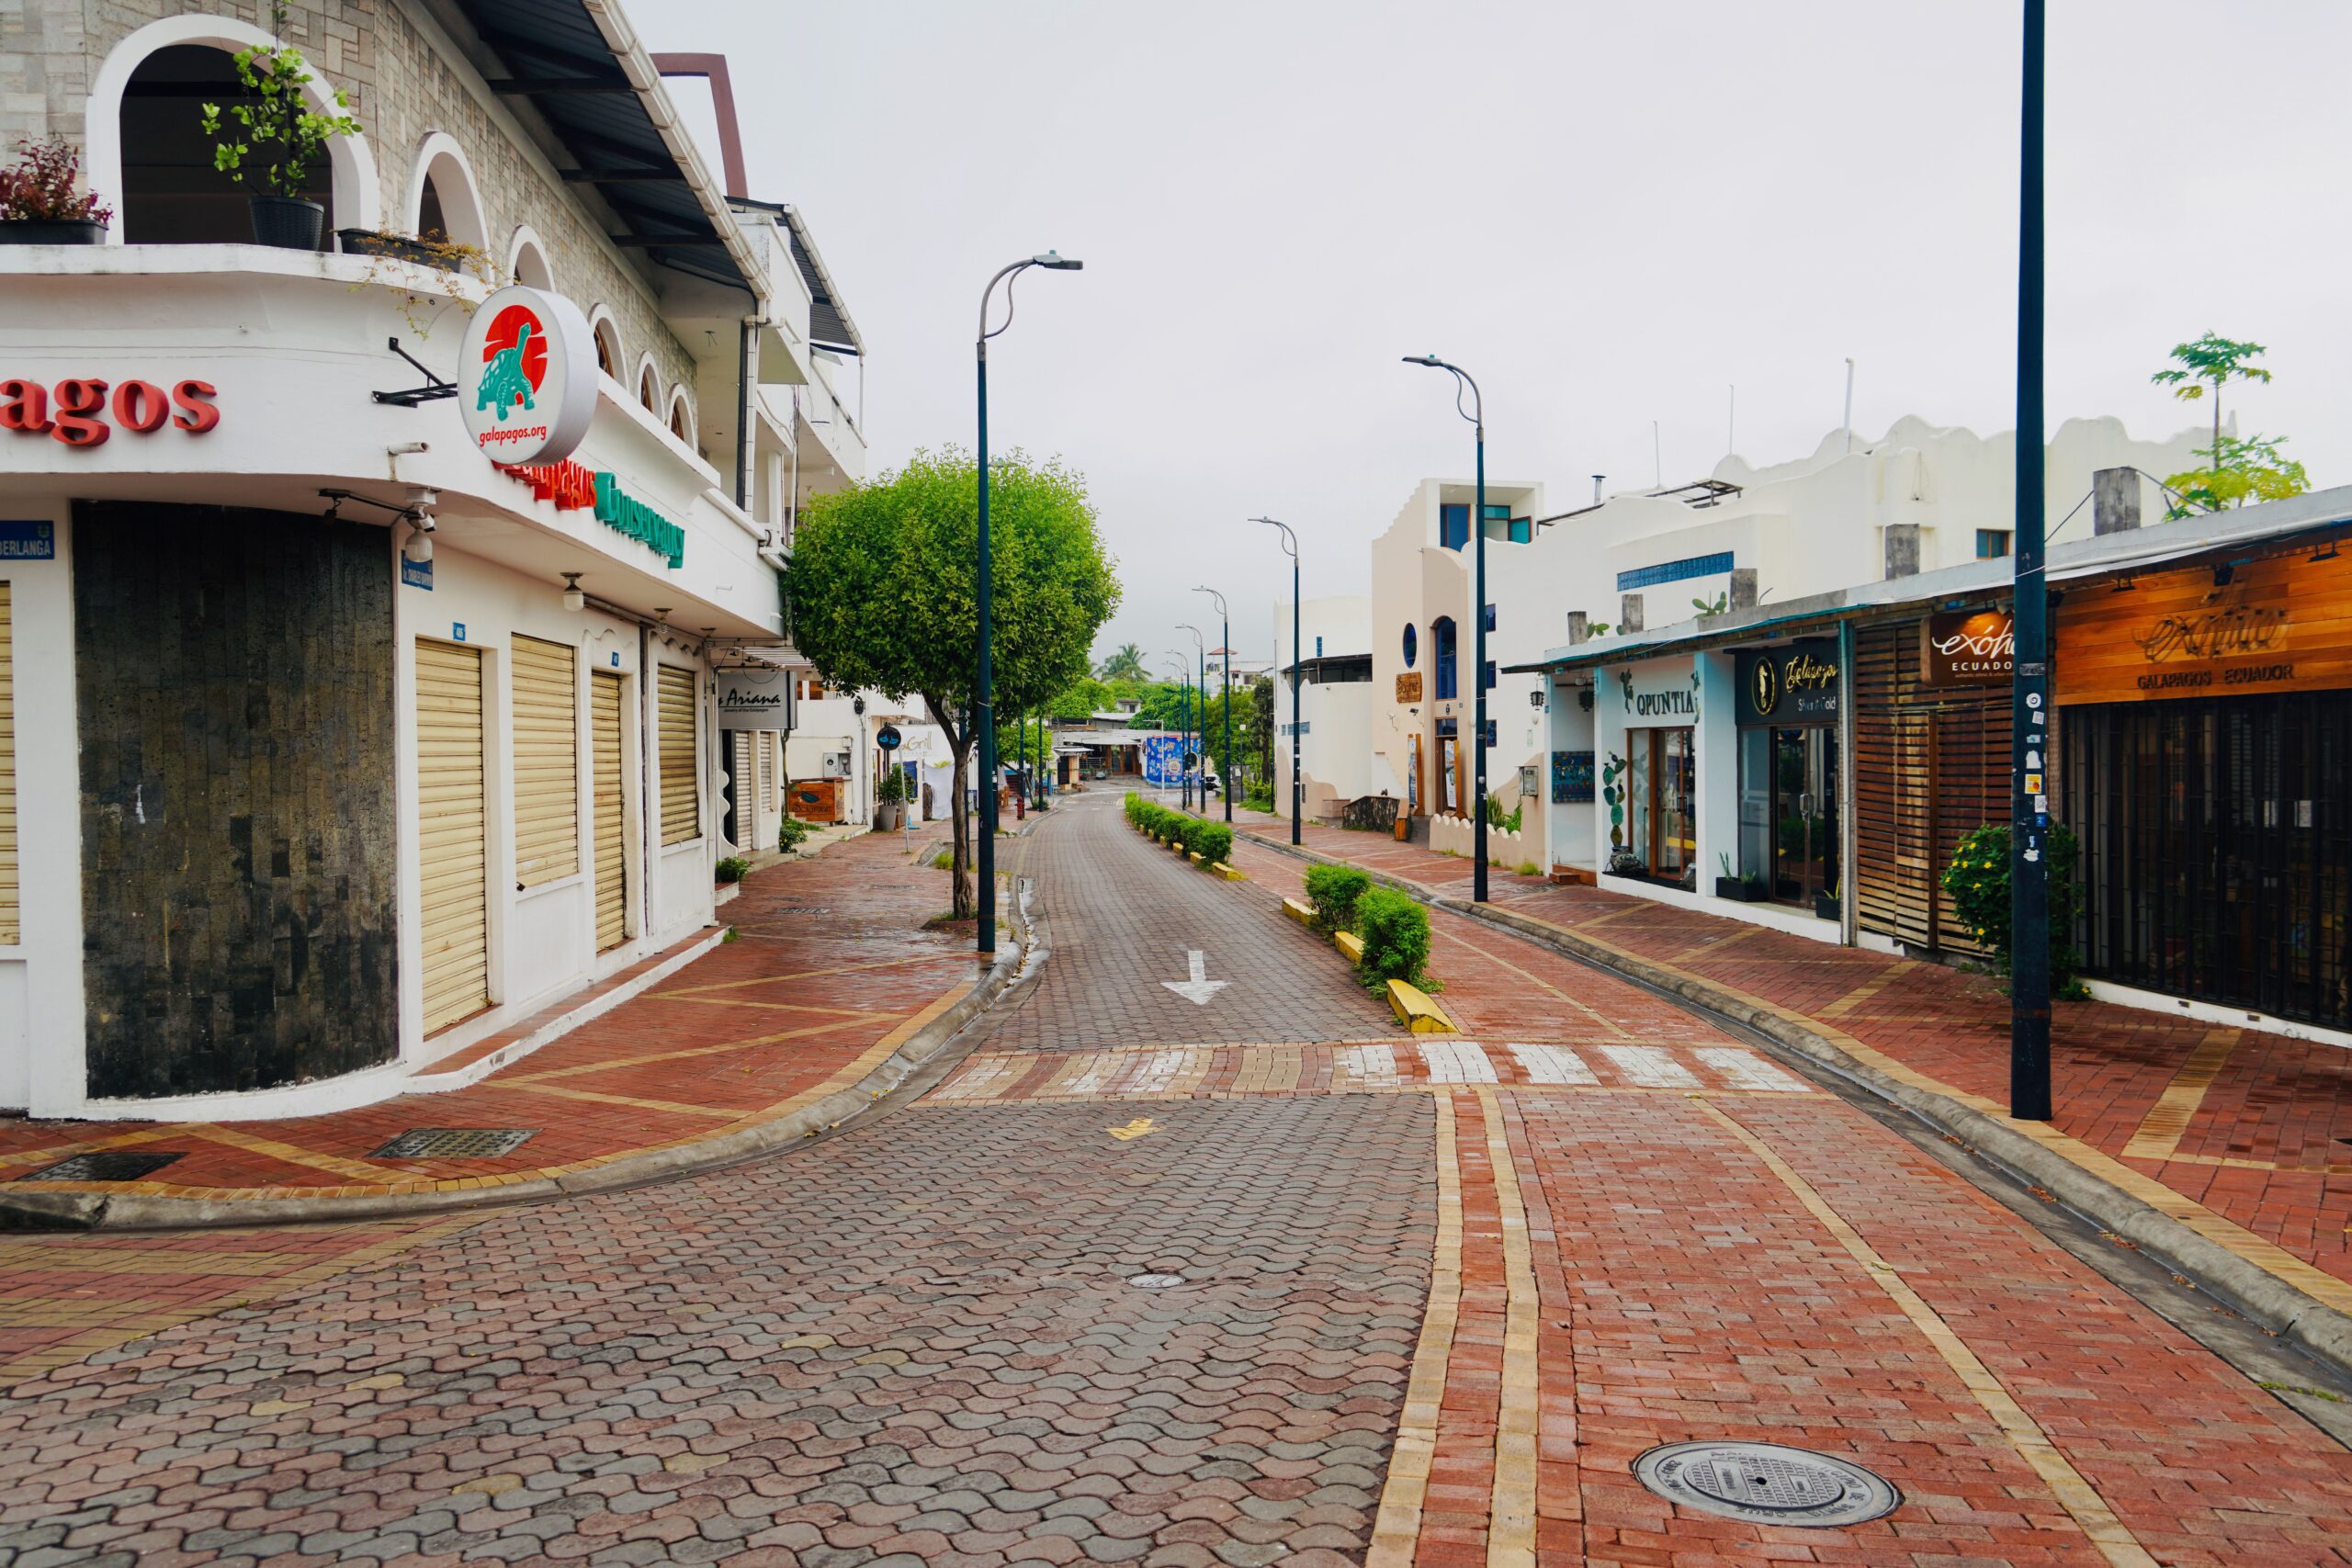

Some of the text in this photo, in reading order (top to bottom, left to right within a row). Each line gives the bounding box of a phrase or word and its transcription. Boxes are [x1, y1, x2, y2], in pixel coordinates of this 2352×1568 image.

[0, 378, 220, 447] agos
[479, 425, 547, 447] galapagos.org
[594, 472, 684, 569] Conservancy
[2137, 664, 2294, 690] GALAPAGOS ECUADOR
[727, 688, 781, 706] Ariana
